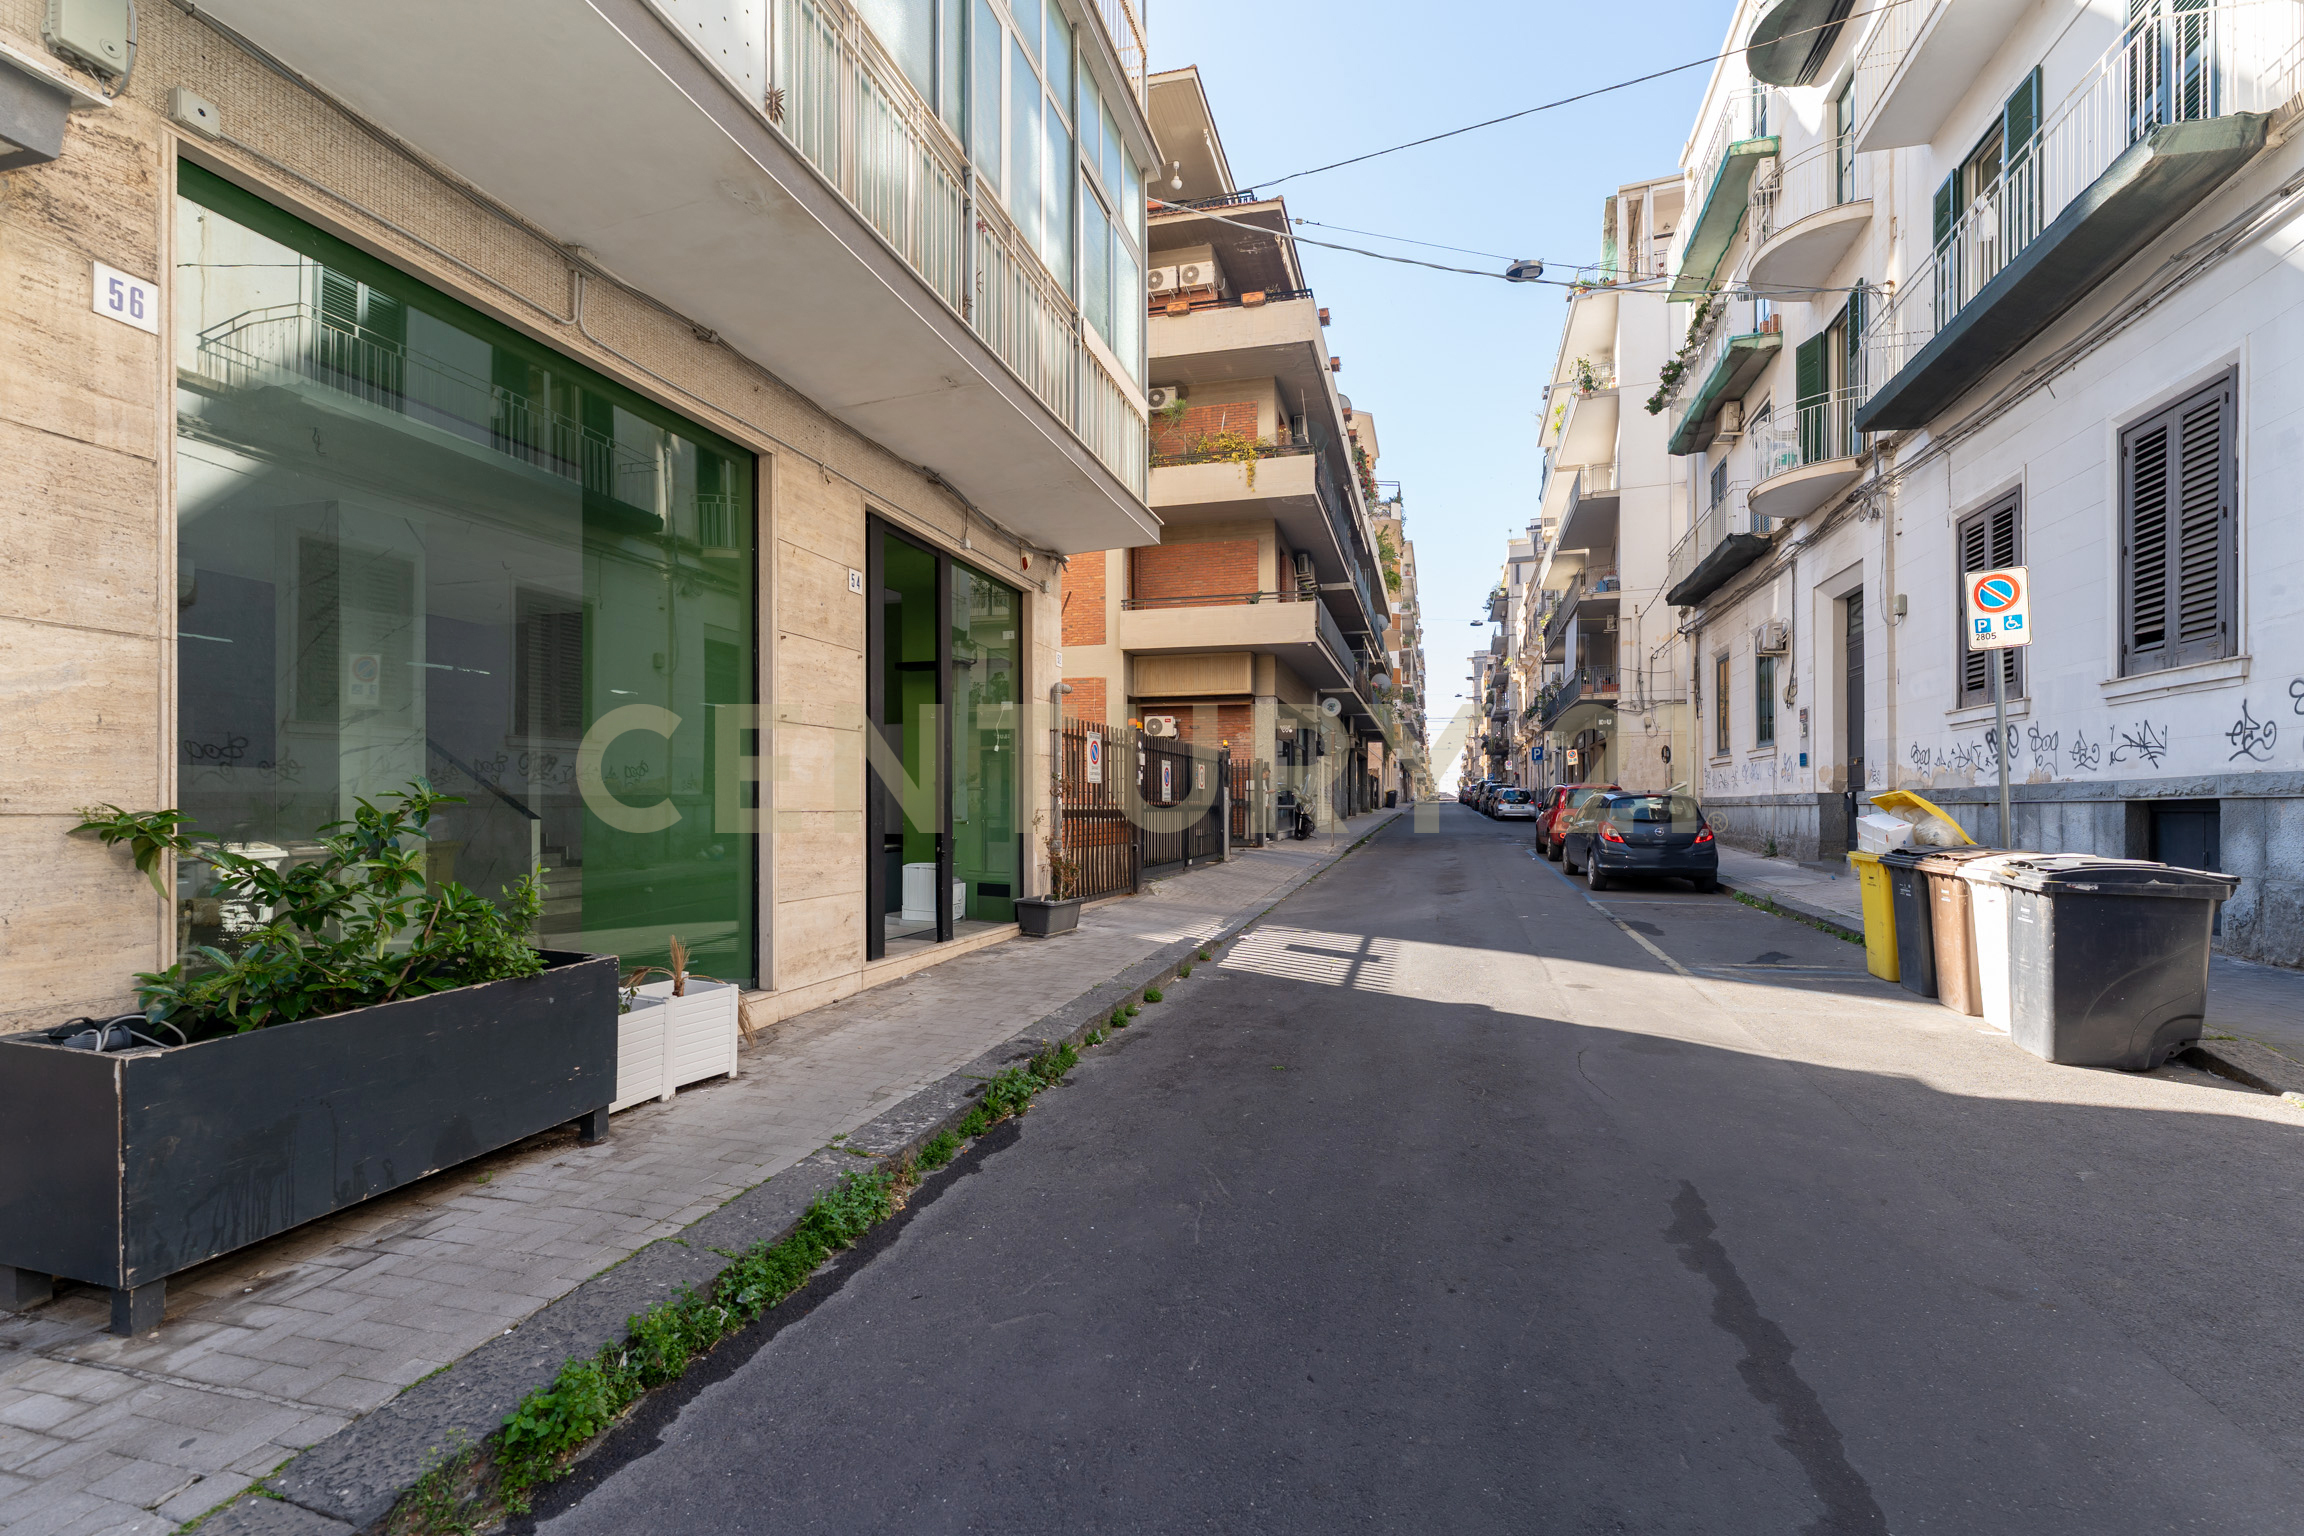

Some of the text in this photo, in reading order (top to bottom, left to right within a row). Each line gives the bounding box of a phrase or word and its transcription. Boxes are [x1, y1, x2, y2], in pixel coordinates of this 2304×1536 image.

[109, 276, 144, 320] 56
[851, 573, 860, 590] 54
[1977, 620, 1988, 632] P
[1975, 632, 1997, 641] 2805
[1533, 748, 1541, 760] P
